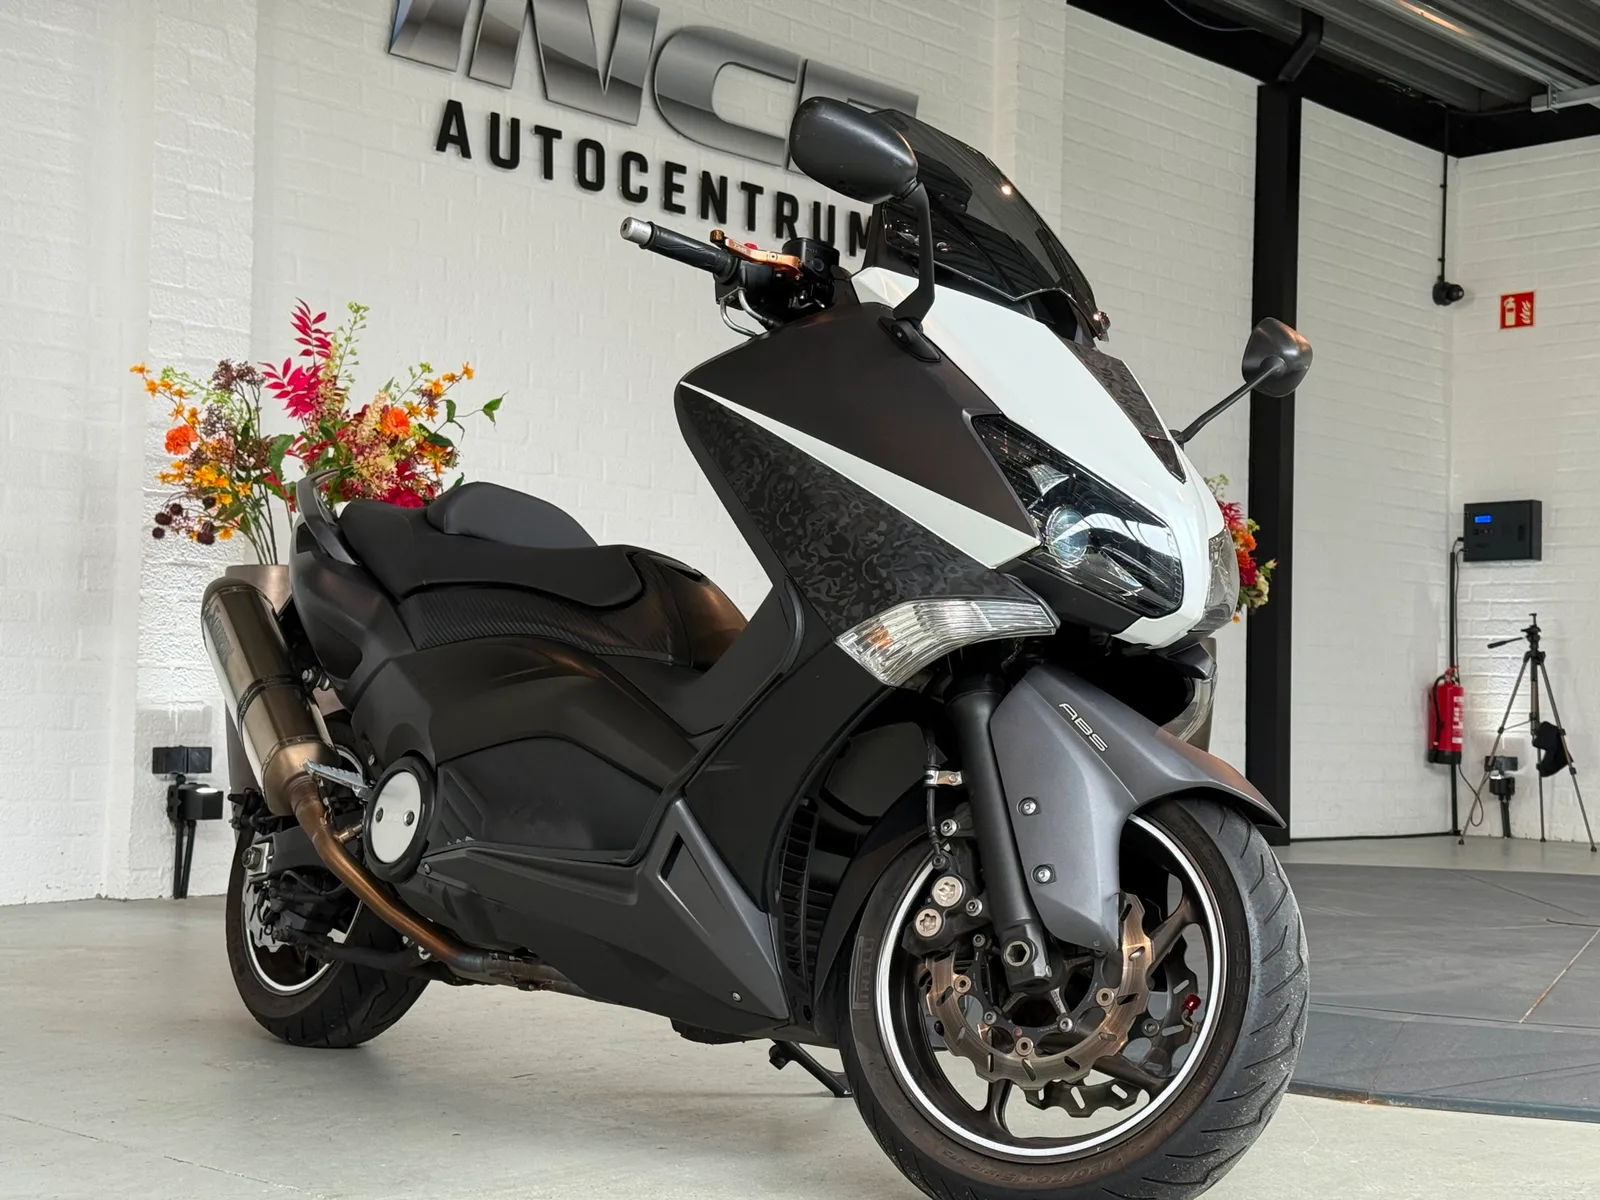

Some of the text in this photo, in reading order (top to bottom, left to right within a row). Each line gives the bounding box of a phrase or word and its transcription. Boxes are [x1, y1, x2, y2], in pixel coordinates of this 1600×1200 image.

[435, 99, 873, 257] AUTOCENTRUM
[1058, 703, 1108, 752] ABS
[852, 935, 874, 1010] PIRELLI
